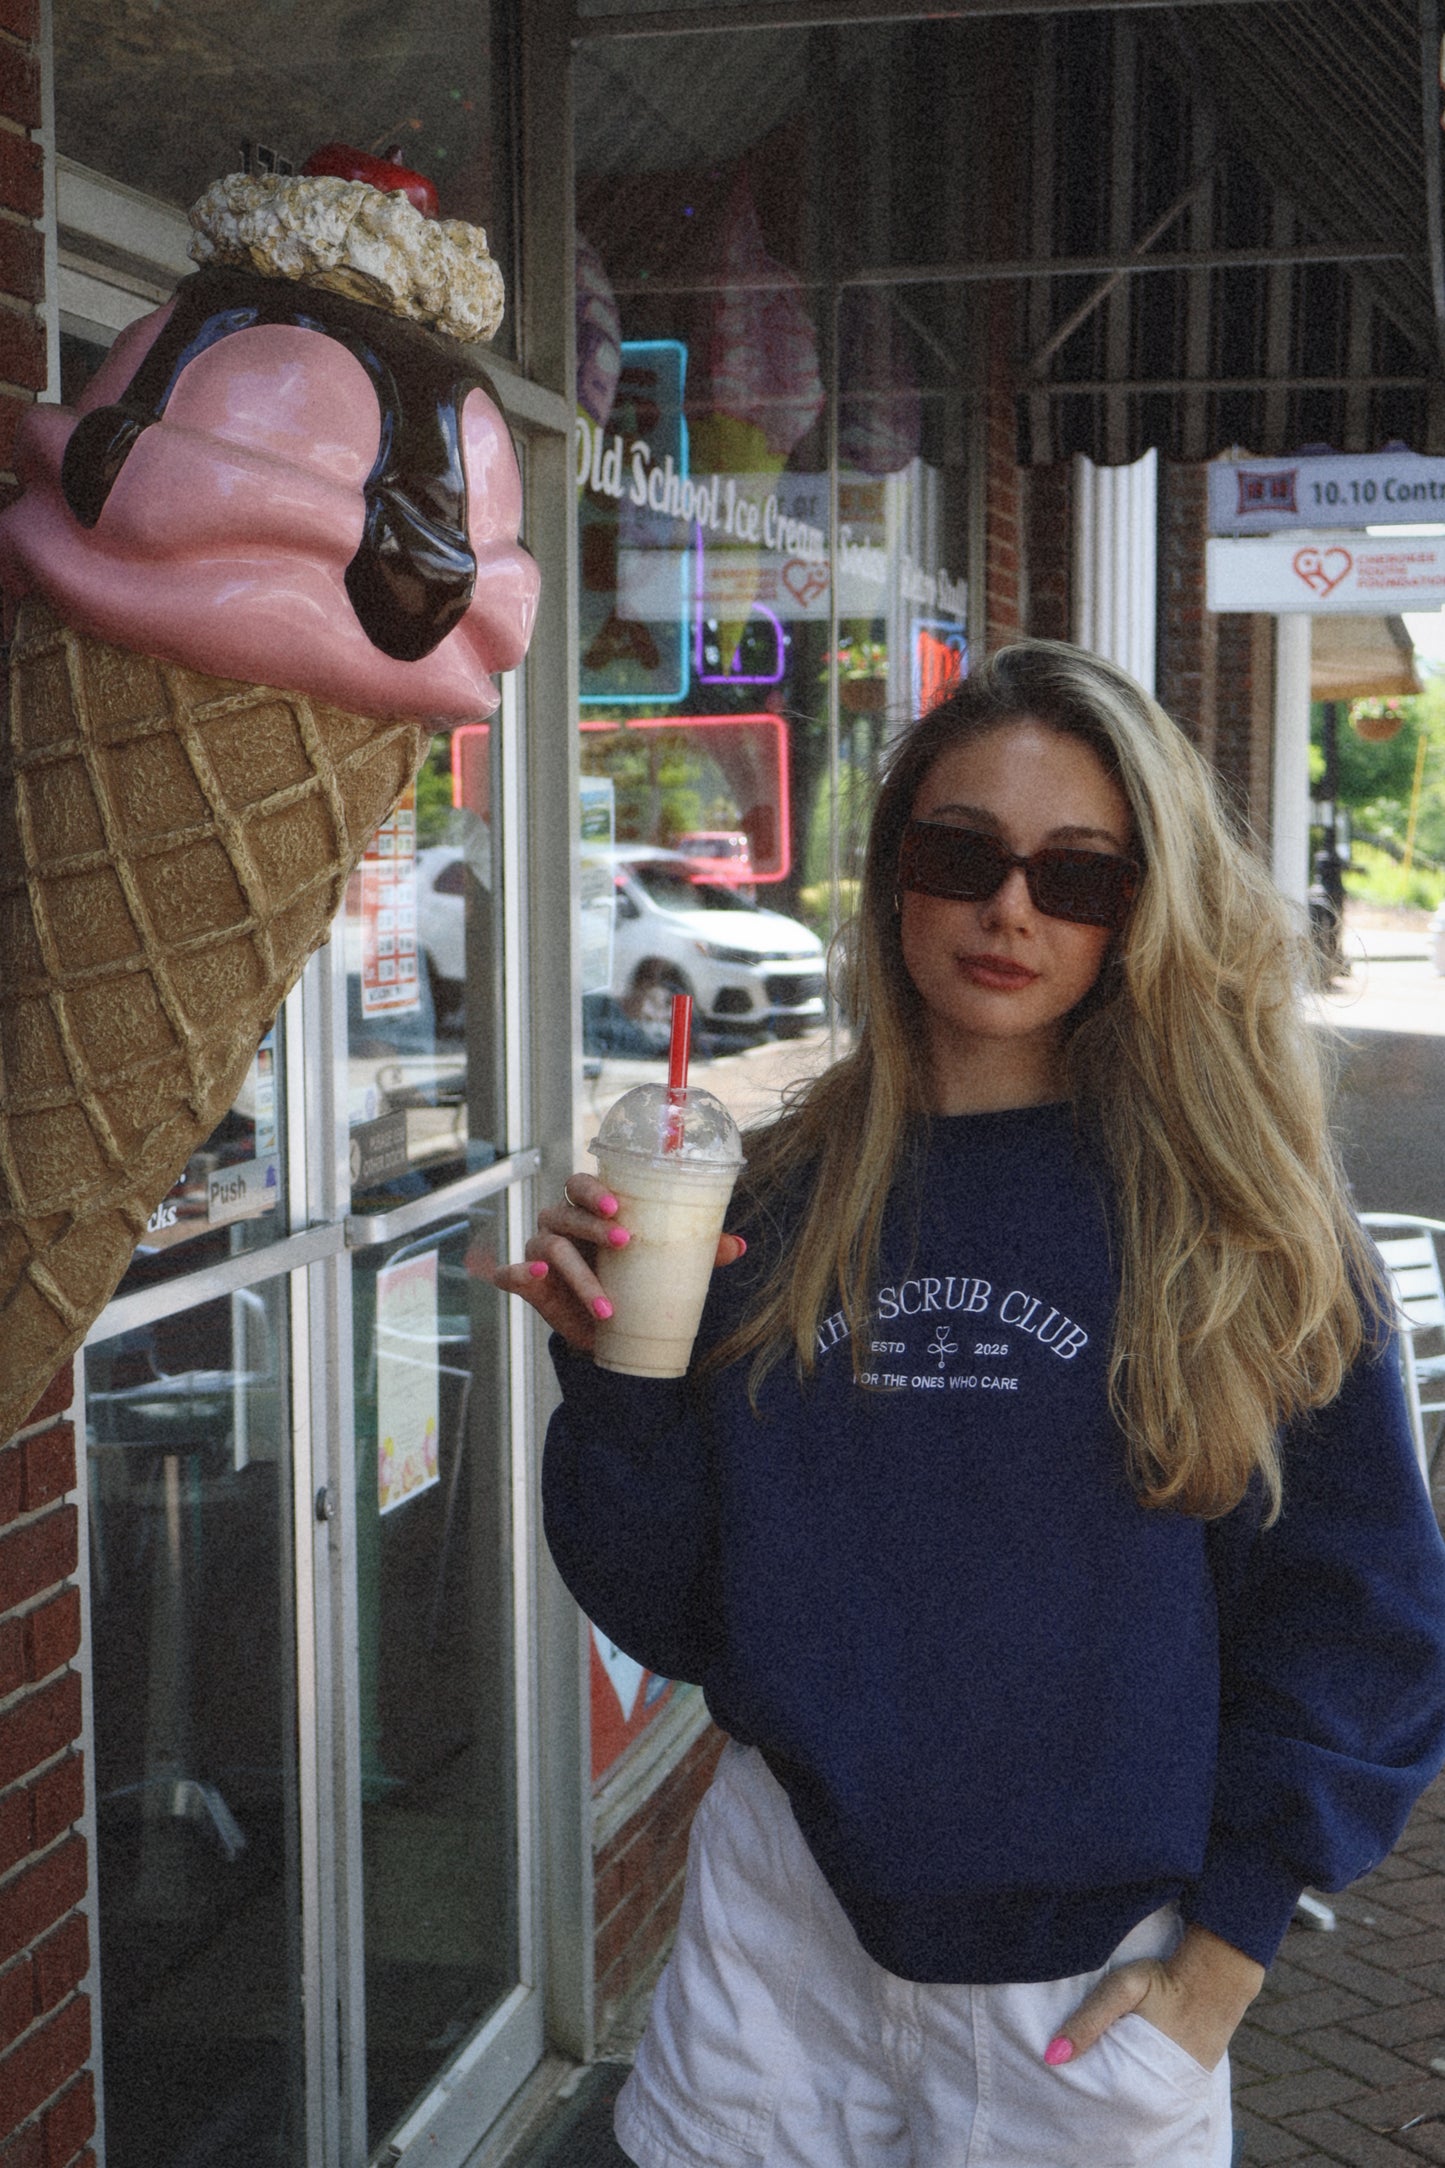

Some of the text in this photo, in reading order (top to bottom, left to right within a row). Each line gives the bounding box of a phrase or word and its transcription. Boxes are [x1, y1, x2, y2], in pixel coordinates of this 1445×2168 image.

[576, 417, 826, 563] Old School Ice Cream
[1313, 480, 1376, 504] 10.10
[209, 1175, 247, 1205] Push
[146, 1203, 178, 1233] cks
[877, 1276, 992, 1321] SCRUB
[999, 1290, 1089, 1360] CLUB
[871, 1341, 906, 1354] ESTD
[882, 1374, 908, 1387] THE
[911, 1376, 945, 1389] ONES
[949, 1376, 978, 1389] WHO
[980, 1376, 1018, 1391] CARE
